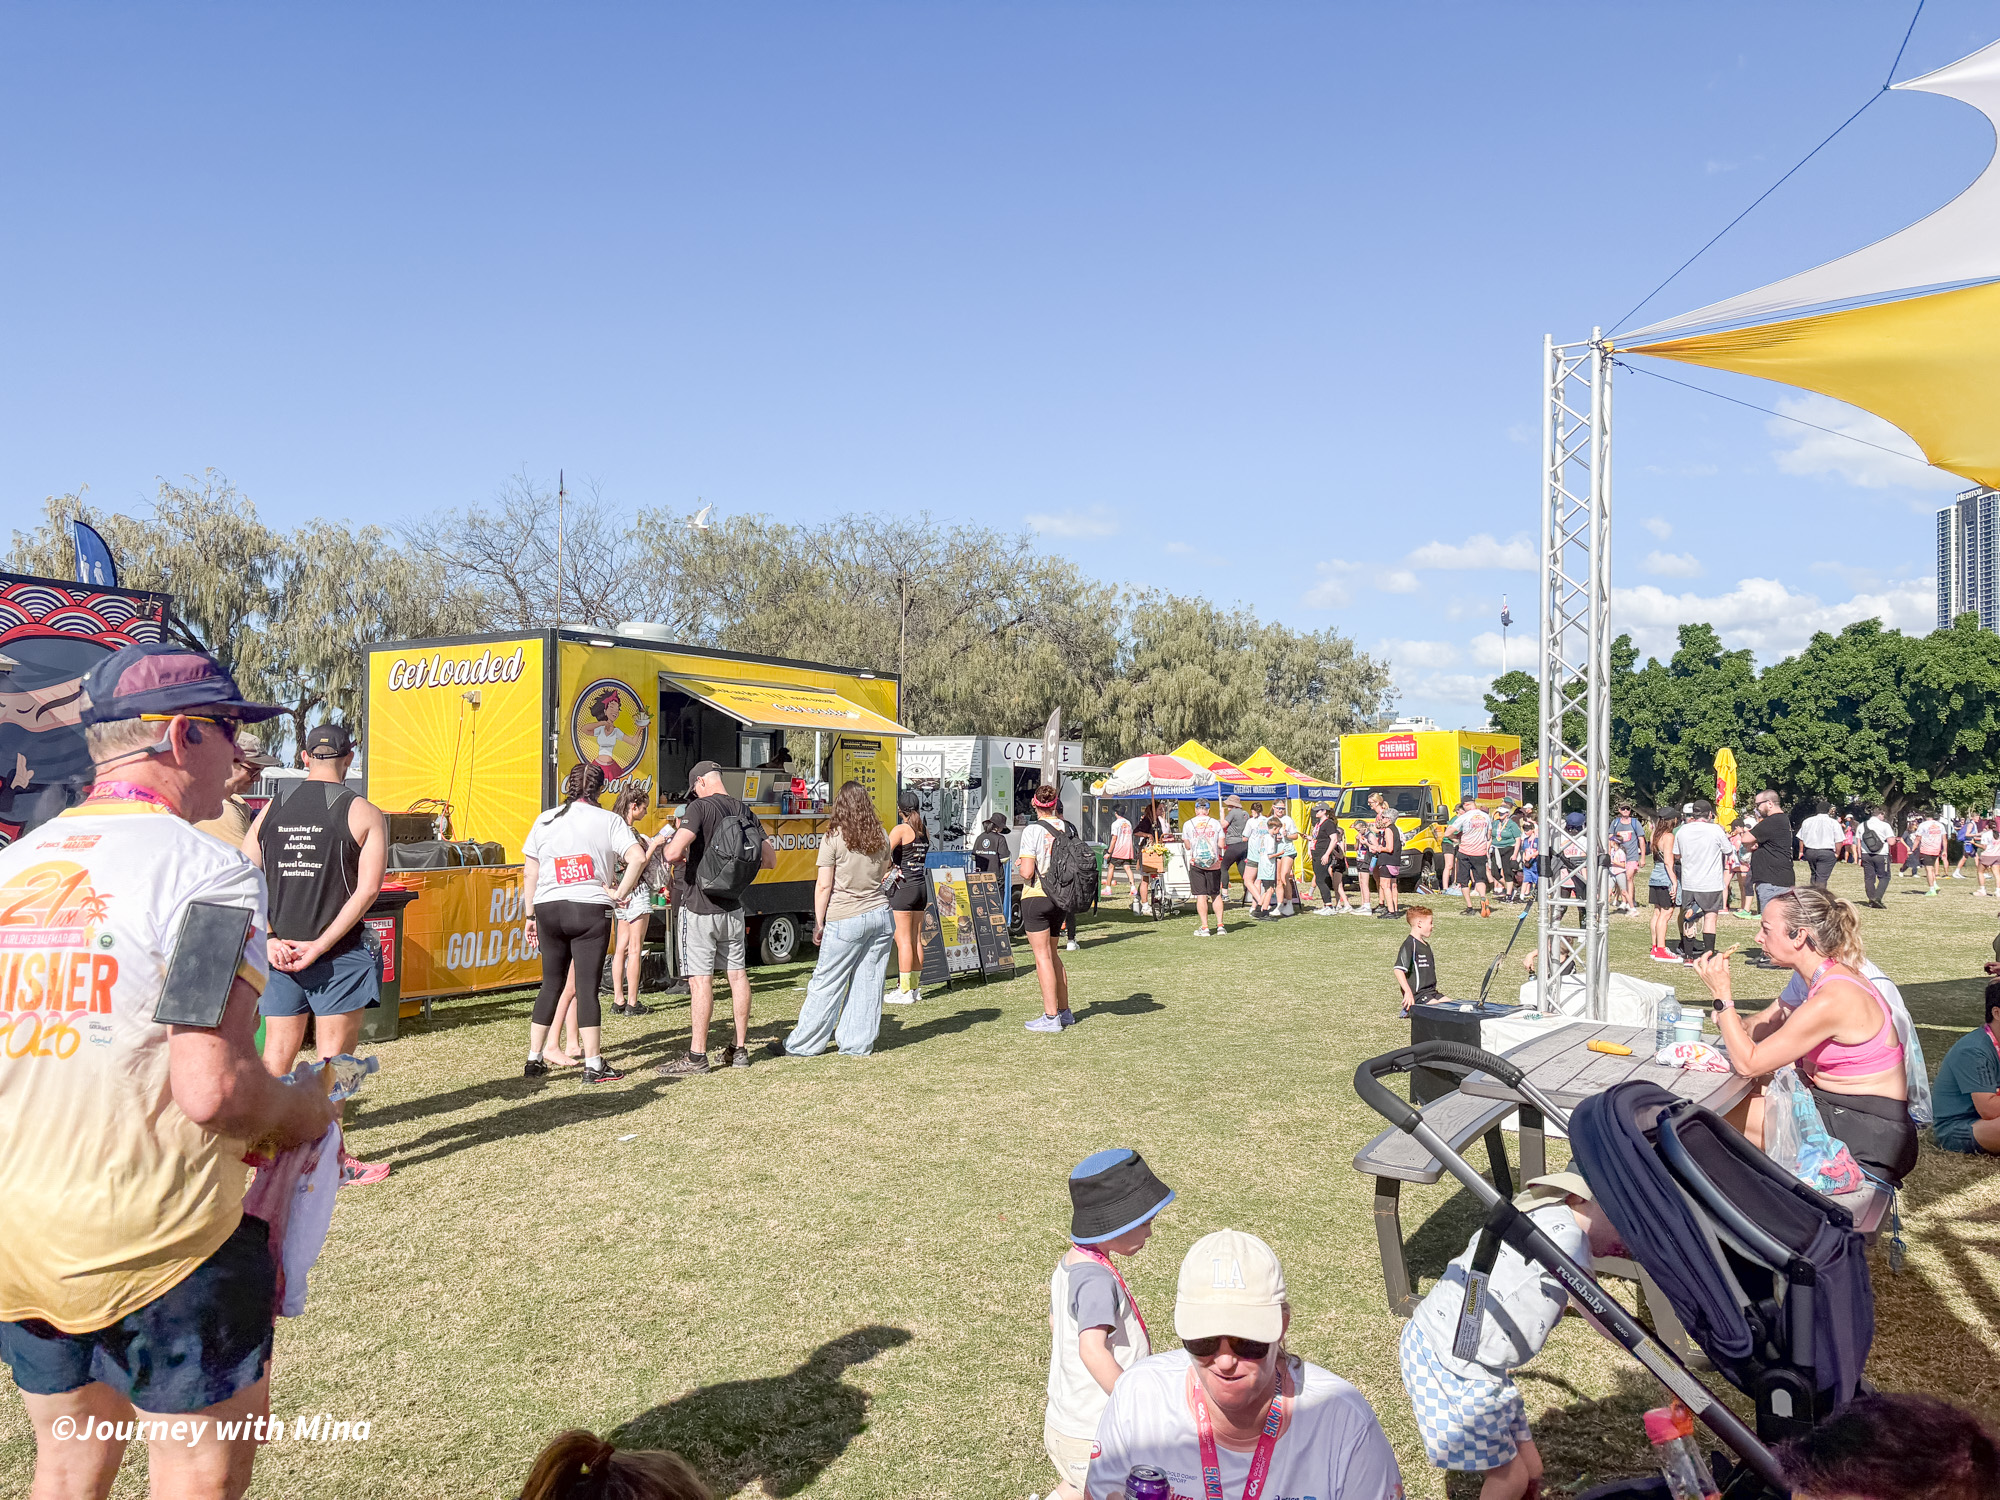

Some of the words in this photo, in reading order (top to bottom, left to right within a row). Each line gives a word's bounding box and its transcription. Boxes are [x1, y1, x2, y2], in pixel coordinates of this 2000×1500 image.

[1956, 488, 1983, 502] MERITON
[388, 658, 429, 691] Get
[428, 647, 525, 688] Loaded
[1004, 742, 1069, 762] COFE
[1380, 743, 1415, 752] CHEMIST
[1152, 785, 1196, 795] WAREHOUSE
[278, 825, 311, 834] Running
[311, 825, 323, 833] for
[560, 863, 590, 880] 53511
[567, 858, 578, 866] MEL
[0, 869, 89, 927] 21
[3, 933, 37, 945] AIRLINES
[446, 929, 503, 970] GOLD
[1211, 1258, 1247, 1290] LA
[1556, 1265, 1607, 1314] redsbaby
[1651, 1346, 1676, 1371] WARNING
[1263, 1409, 1282, 1438] 5KM
